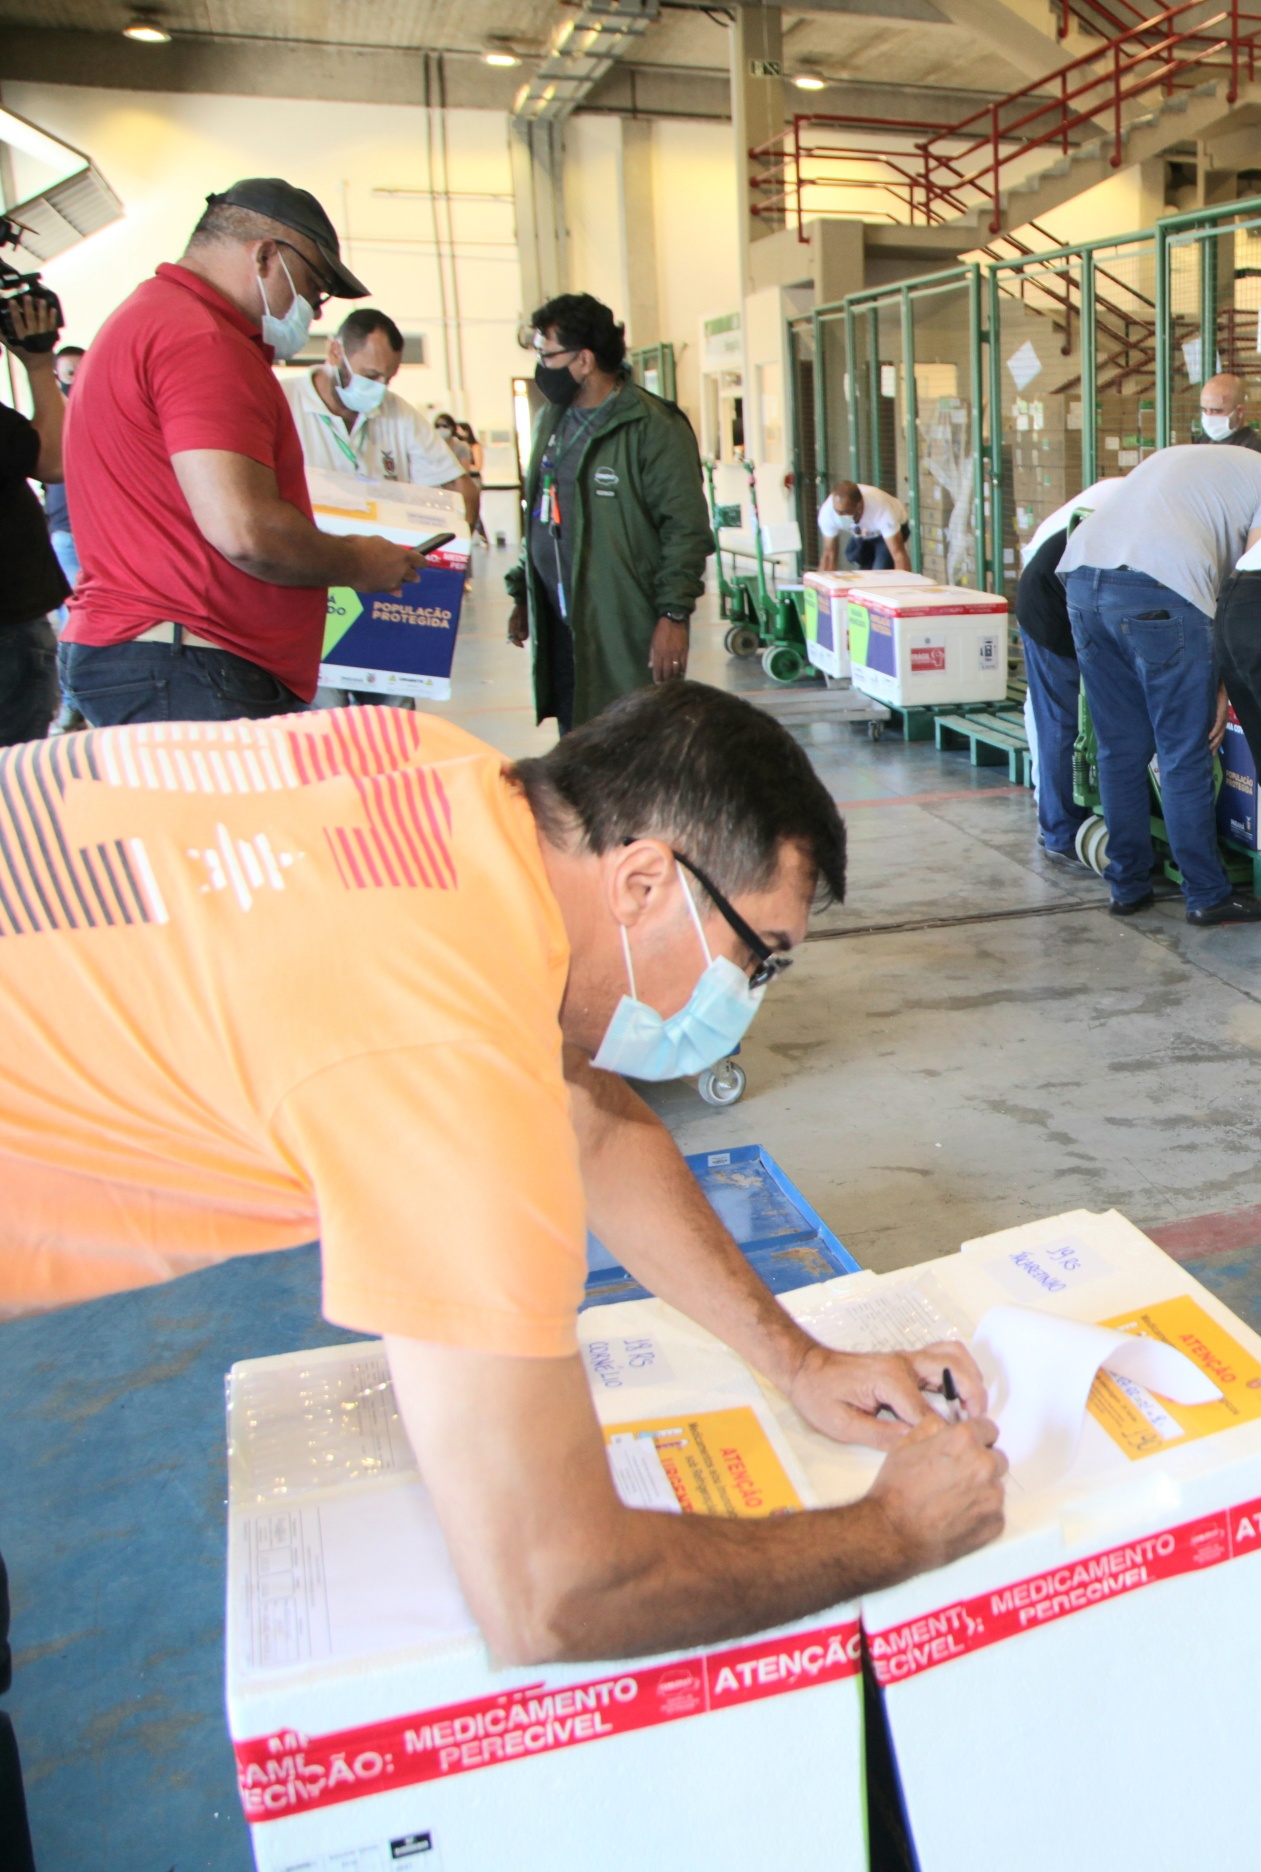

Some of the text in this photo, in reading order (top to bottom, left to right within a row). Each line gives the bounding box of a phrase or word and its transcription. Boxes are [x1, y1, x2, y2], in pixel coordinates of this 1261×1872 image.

[372, 602, 452, 618] POPULAÇÃO
[372, 610, 450, 628] PROTEGIDA
[1140, 1314, 1177, 1349] Medicame
[589, 1342, 624, 1388] CORNÉLIO
[1179, 1334, 1236, 1385] ATENÇÃO
[662, 1458, 694, 1514] URGENT
[720, 1448, 763, 1508] ATENÇÃO
[991, 1533, 1175, 1614] MEDICAMENTO
[875, 1634, 964, 1680] ECÍVEL
[405, 1677, 638, 1754] MEDICAMENTO
[714, 1634, 862, 1694] ATENÇÃO
[440, 1711, 612, 1772] PERECÍVEL
